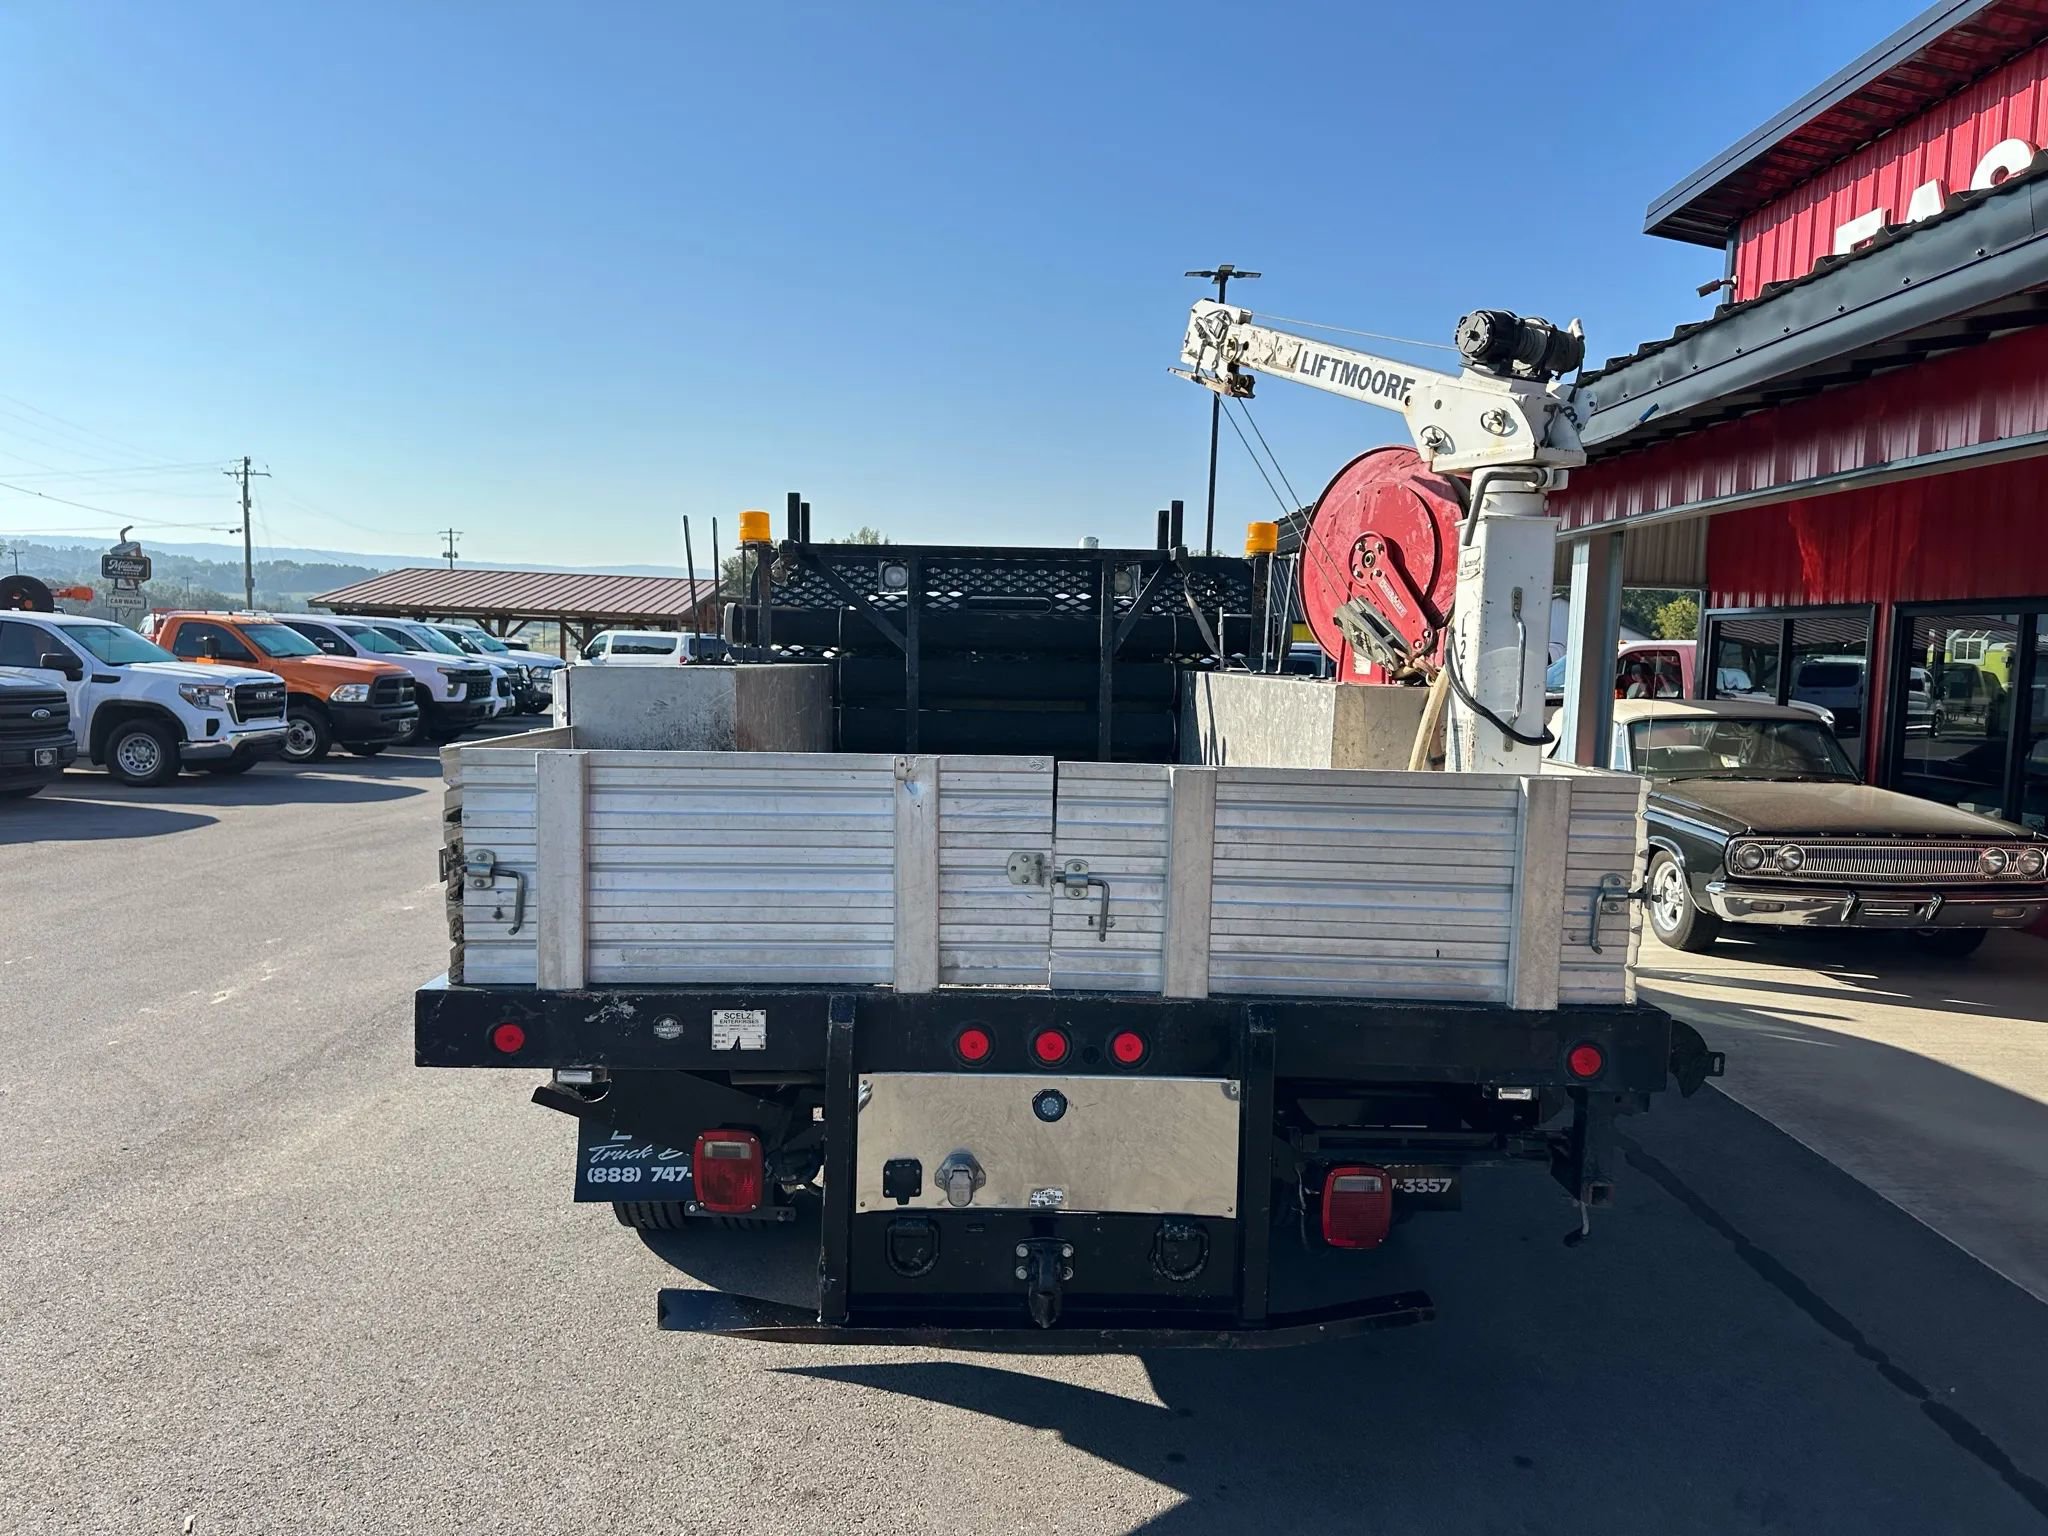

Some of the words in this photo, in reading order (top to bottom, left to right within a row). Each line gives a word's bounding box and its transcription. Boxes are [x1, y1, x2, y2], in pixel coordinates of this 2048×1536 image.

[588, 1144, 654, 1163] Truck
[587, 1166, 642, 1183] (888)
[650, 1166, 693, 1182] 747-
